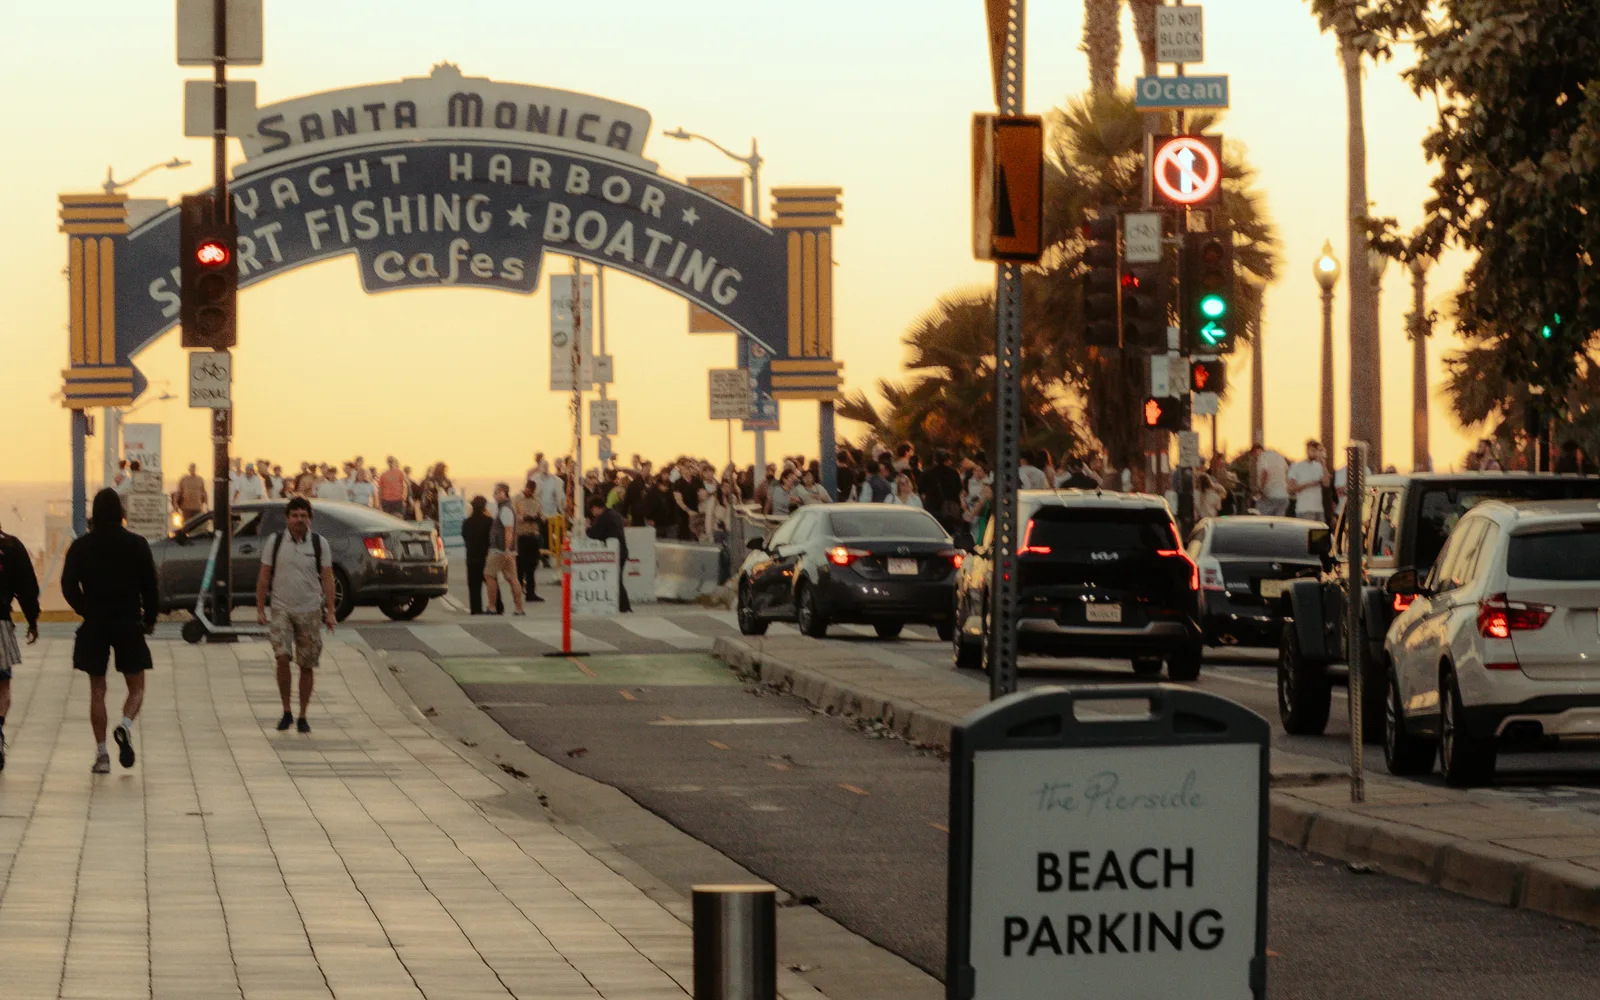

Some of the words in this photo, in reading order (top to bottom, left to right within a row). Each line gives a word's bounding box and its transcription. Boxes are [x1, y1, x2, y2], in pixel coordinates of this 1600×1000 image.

[1160, 13, 1175, 26] DO
[1178, 12, 1199, 25] NOT
[1160, 31, 1200, 45] BLOCK
[1143, 79, 1222, 100] Ocean
[257, 100, 417, 154] SANTA
[447, 92, 633, 151] MONICA
[233, 153, 408, 220] YACHT
[450, 152, 666, 219] HARBOR
[148, 221, 283, 319] SRT
[304, 193, 493, 251] FISHING
[543, 201, 743, 306] BOATING
[191, 387, 228, 400] SIGNAL
[599, 418, 610, 433] 5
[579, 569, 609, 582] LOT
[576, 589, 613, 602] FULL
[1083, 768, 1202, 818] Pierside
[1036, 846, 1194, 893] BEACH
[1002, 907, 1226, 957] PARKING
